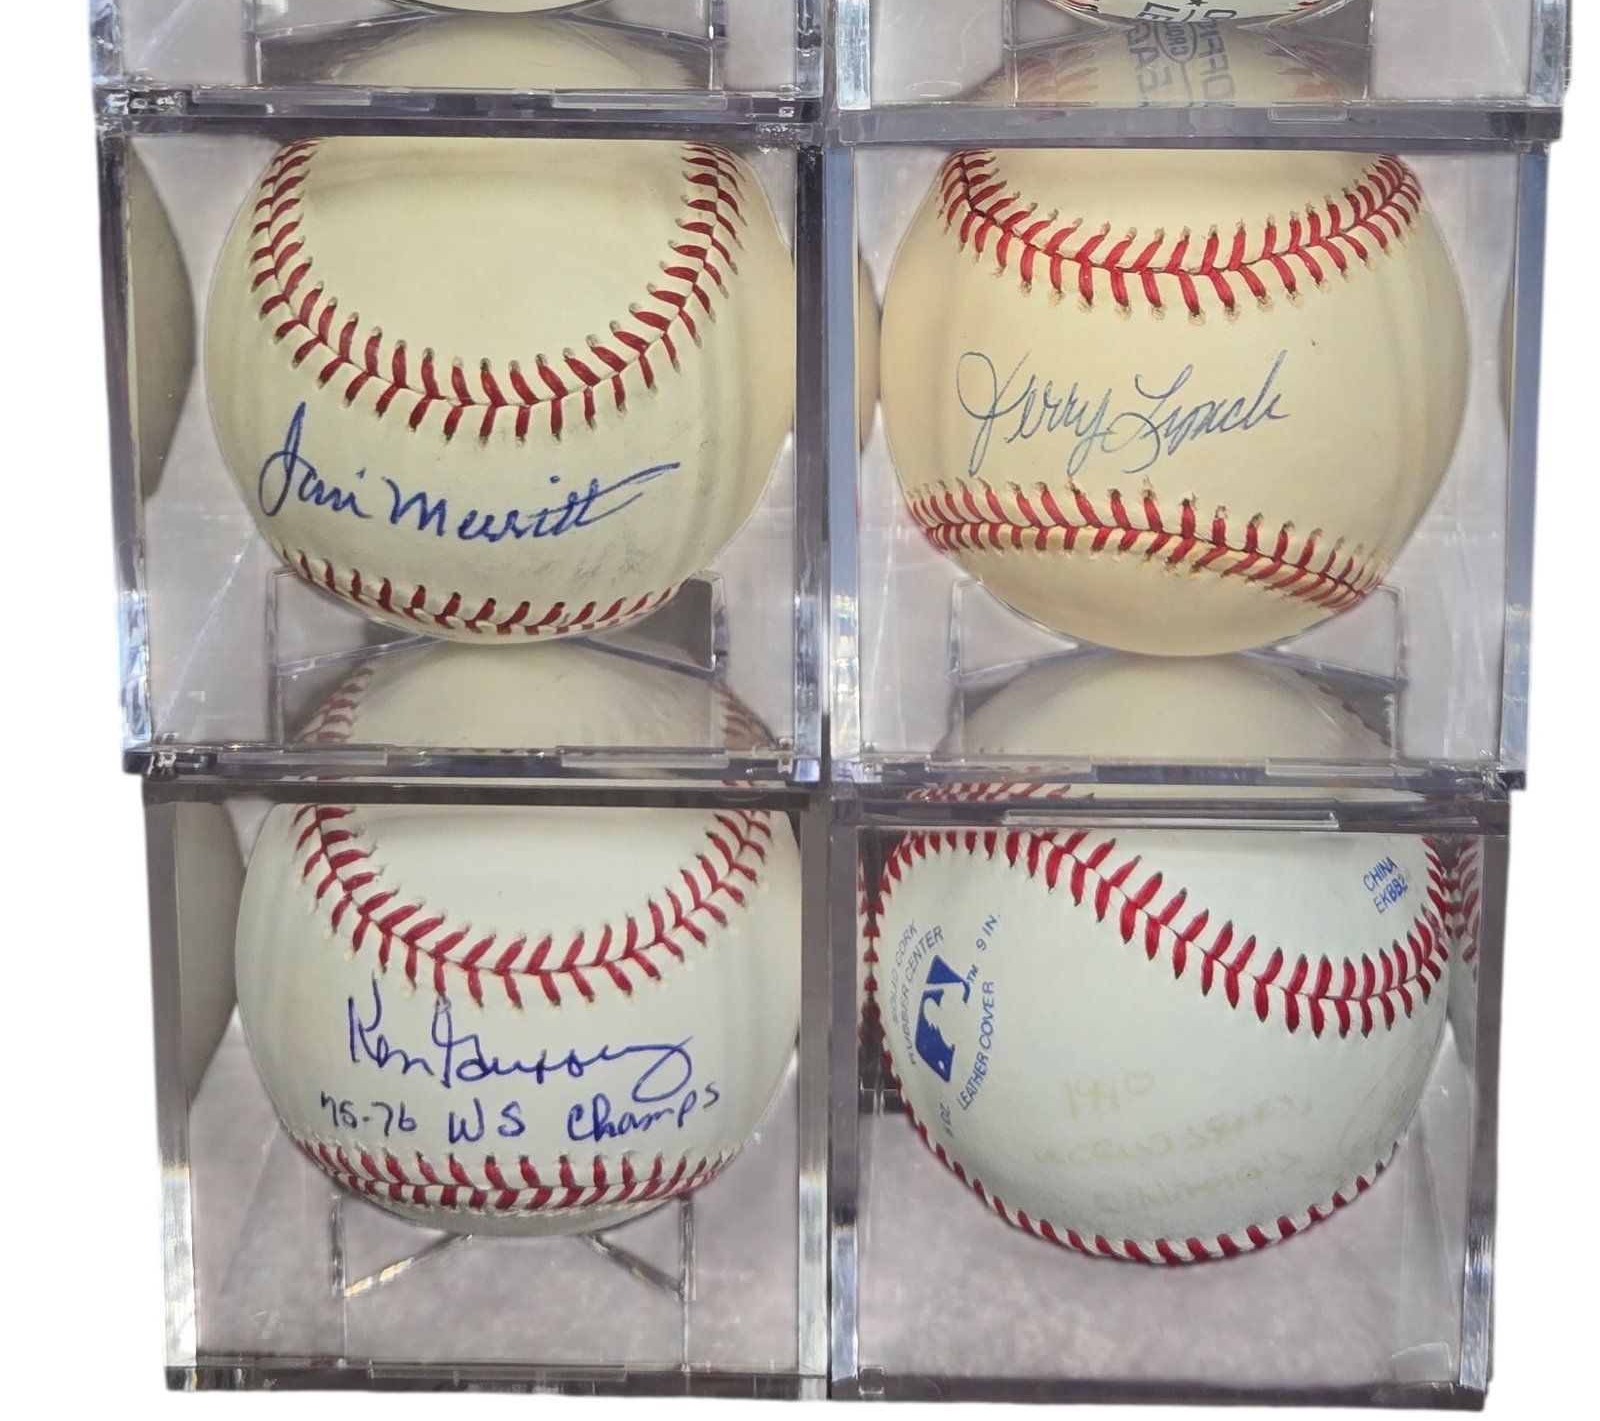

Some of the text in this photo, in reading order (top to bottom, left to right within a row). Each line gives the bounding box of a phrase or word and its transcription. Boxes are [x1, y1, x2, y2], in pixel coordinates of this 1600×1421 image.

[956, 348, 1118, 478] Jerry
[1362, 855, 1398, 892] CHINA
[894, 919, 919, 968] CORK
[904, 925, 945, 983] CENTER
[974, 937, 989, 953] 9
[956, 980, 996, 1112] LEATHER COVER
